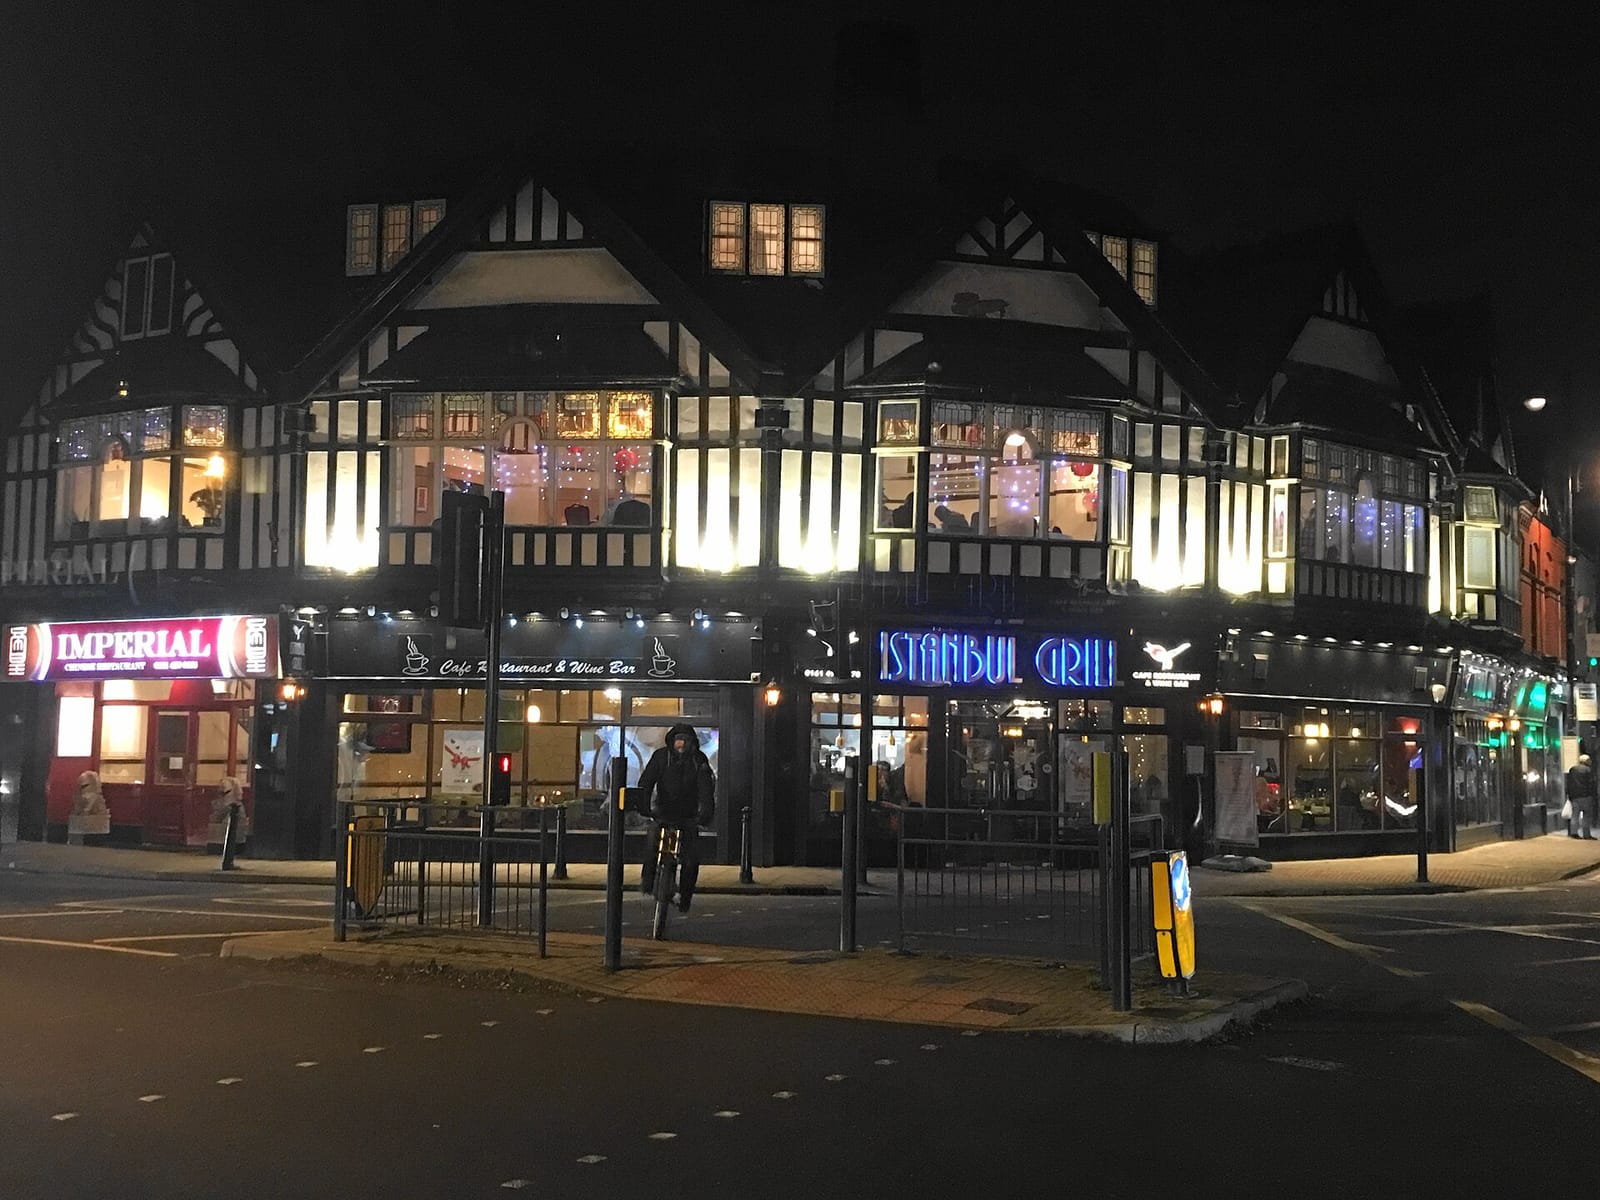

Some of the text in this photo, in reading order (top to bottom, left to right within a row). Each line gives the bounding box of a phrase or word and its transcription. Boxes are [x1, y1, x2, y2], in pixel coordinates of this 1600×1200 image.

[56, 629, 212, 660] IMPERIAL
[879, 630, 1124, 688] ISTANBUL GRILL
[439, 659, 472, 676] Cafe
[555, 660, 566, 673] &
[568, 660, 604, 674] Wine
[608, 660, 636, 674] Bar
